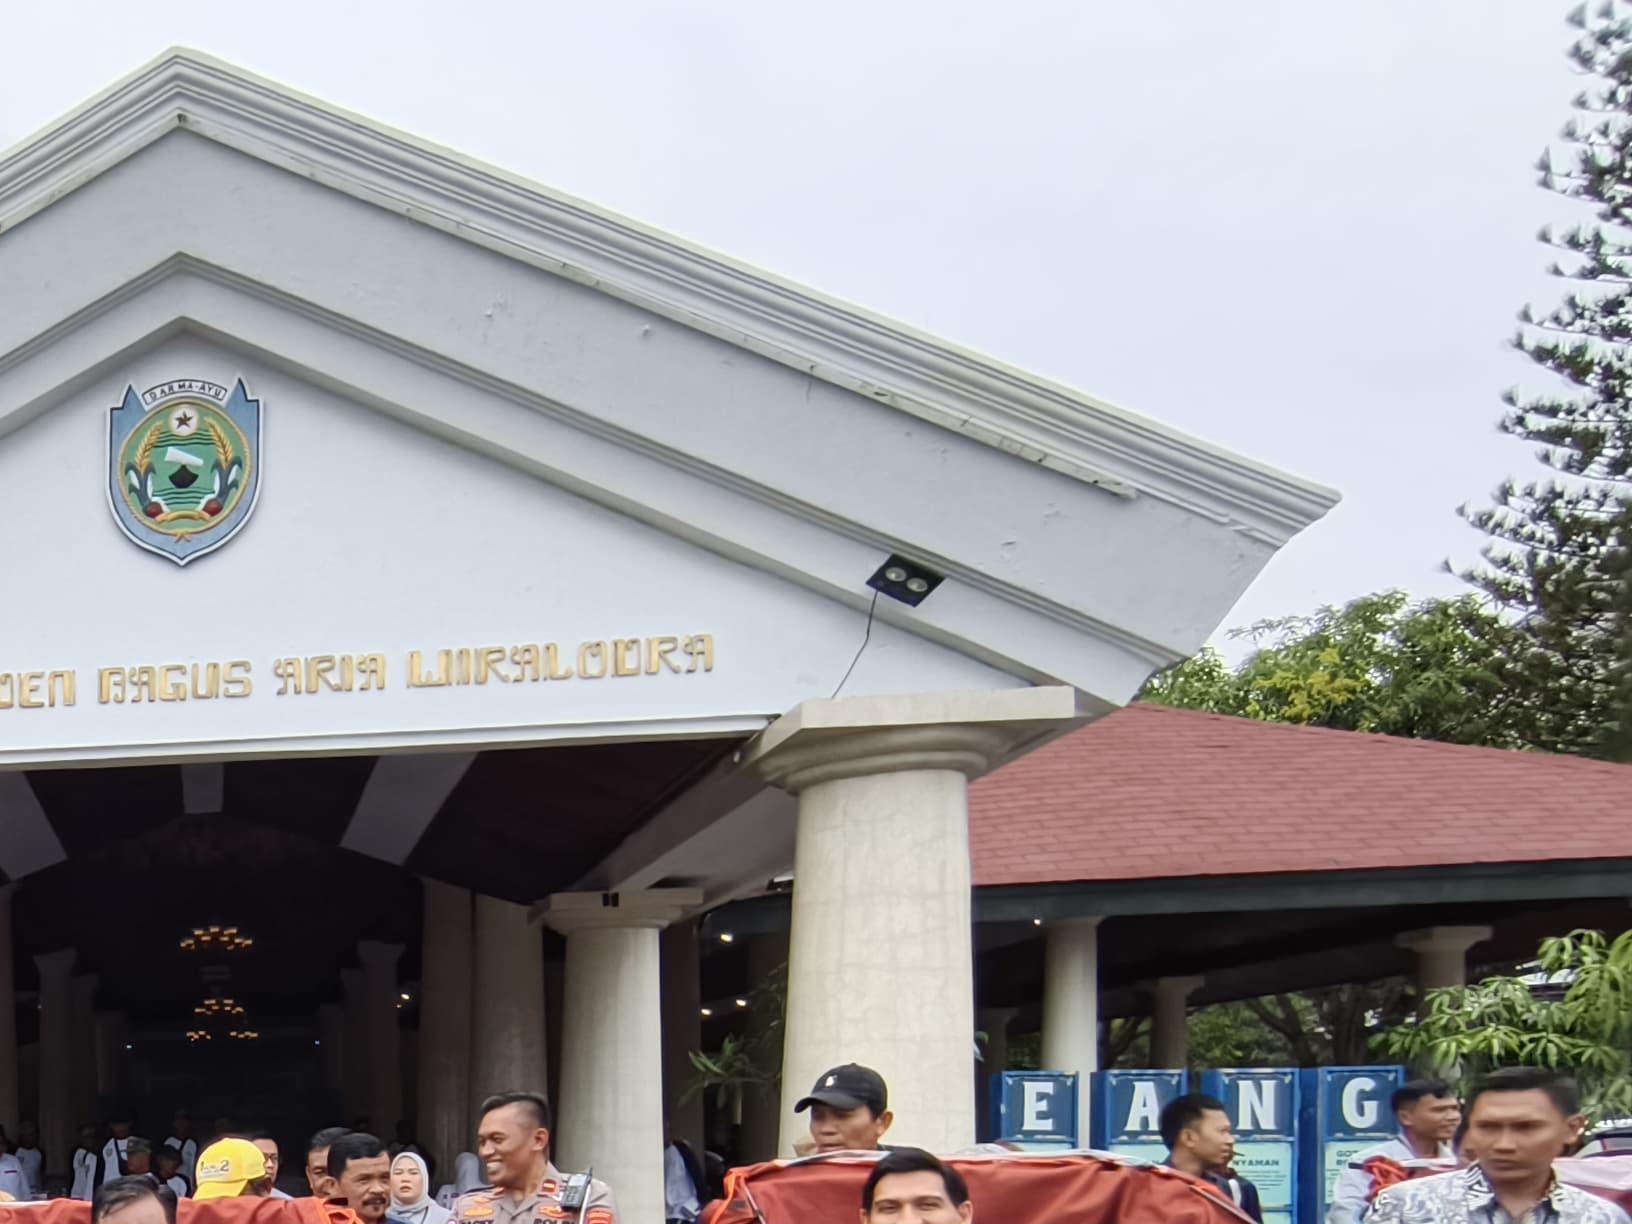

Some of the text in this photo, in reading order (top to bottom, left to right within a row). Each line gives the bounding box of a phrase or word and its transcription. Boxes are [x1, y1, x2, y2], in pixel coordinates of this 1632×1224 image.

[98, 660, 252, 704] BAGUS
[274, 653, 386, 696] ARIA
[406, 633, 714, 689] WIRALODRA
